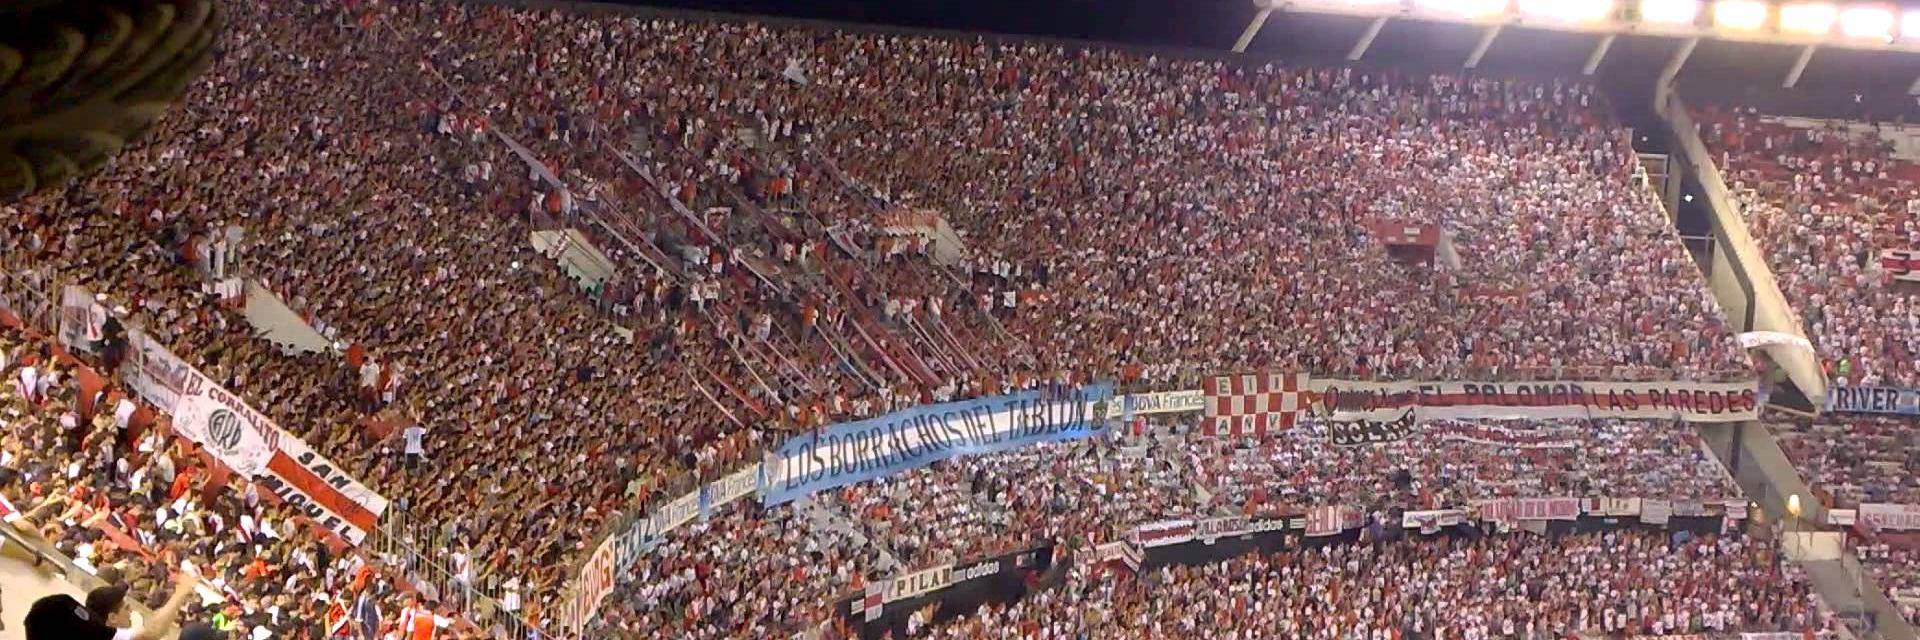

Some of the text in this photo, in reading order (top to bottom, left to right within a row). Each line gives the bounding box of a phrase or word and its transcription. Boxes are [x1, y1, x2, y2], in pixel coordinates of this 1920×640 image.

[186, 372, 280, 452] EL CORRALITO
[1591, 387, 1754, 414] LAS PAREDES
[1837, 387, 1899, 411] RIVER
[783, 429, 825, 491] LOS
[829, 411, 966, 477] BORRACHOS
[960, 404, 1002, 447] DEL
[298, 452, 351, 489] SAN
[263, 475, 352, 541] MIGUEL
[897, 568, 951, 597] PILAR
[966, 561, 1000, 579] adidas
